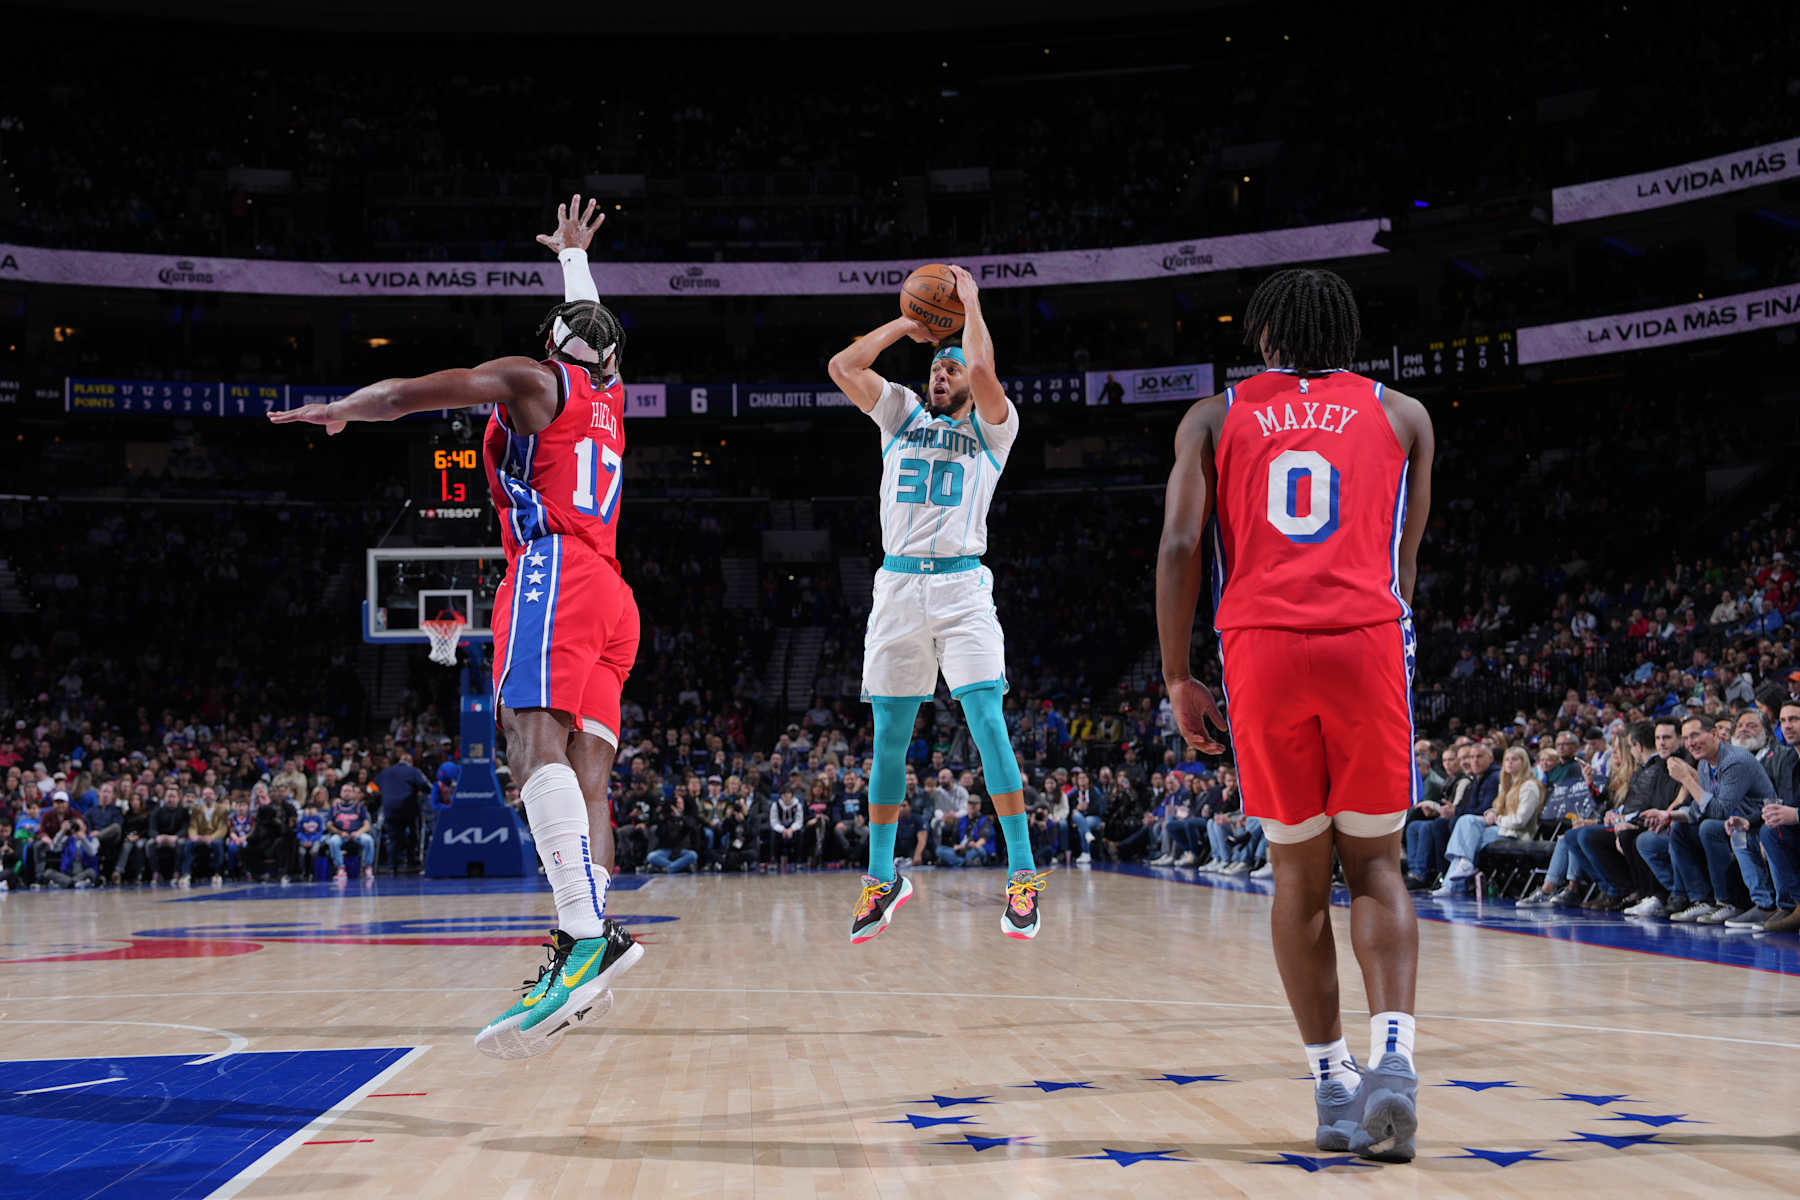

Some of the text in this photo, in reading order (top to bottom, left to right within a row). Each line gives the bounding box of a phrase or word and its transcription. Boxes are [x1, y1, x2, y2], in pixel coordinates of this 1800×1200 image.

[1637, 182, 1660, 197] LA
[1666, 169, 1724, 194] VIDA
[1731, 152, 1786, 181] MÁS
[1163, 254, 1212, 271] Corona
[158, 267, 214, 285] Corona
[338, 268, 543, 287] LA VIDA MÁS FINA
[670, 274, 721, 291] Corona
[839, 272, 857, 283] LA
[864, 270, 911, 286] VID
[981, 262, 1037, 280] FINA
[909, 300, 953, 328] Wilson
[1588, 329, 1611, 343] LA
[1616, 318, 1676, 340] VIDA
[1684, 305, 1737, 330] MÁS
[1226, 364, 1266, 379] MARC
[1371, 358, 1390, 371] PM
[1403, 353, 1423, 367] PHI
[1401, 365, 1426, 378] CHA
[73, 384, 115, 396] PLAYER
[121, 385, 134, 396] 17
[142, 385, 154, 397] 12
[182, 386, 192, 397] 0
[231, 386, 279, 398] FLS TOL
[1033, 380, 1042, 391] 4
[1069, 378, 1079, 389] 11
[1138, 376, 1157, 390] JO
[73, 397, 115, 409] POINTS
[163, 399, 172, 410] 0
[202, 400, 212, 411] 0
[637, 395, 657, 407] 1ST
[691, 387, 708, 414] 6
[749, 392, 856, 407] CHARLOTTE HORN
[1033, 392, 1042, 403] 0
[1051, 392, 1061, 402] 0
[1069, 391, 1079, 402] 0
[237, 400, 245, 413] 1
[591, 401, 617, 440] HIELD
[1253, 402, 1358, 437] MAXEY
[899, 427, 977, 458] CHARLOTTE
[433, 449, 477, 469] 6:40
[441, 469, 466, 502] 1.3
[573, 437, 623, 526] 17
[896, 458, 965, 506] 30
[1266, 449, 1340, 544] 0
[436, 508, 482, 519] TISSOT
